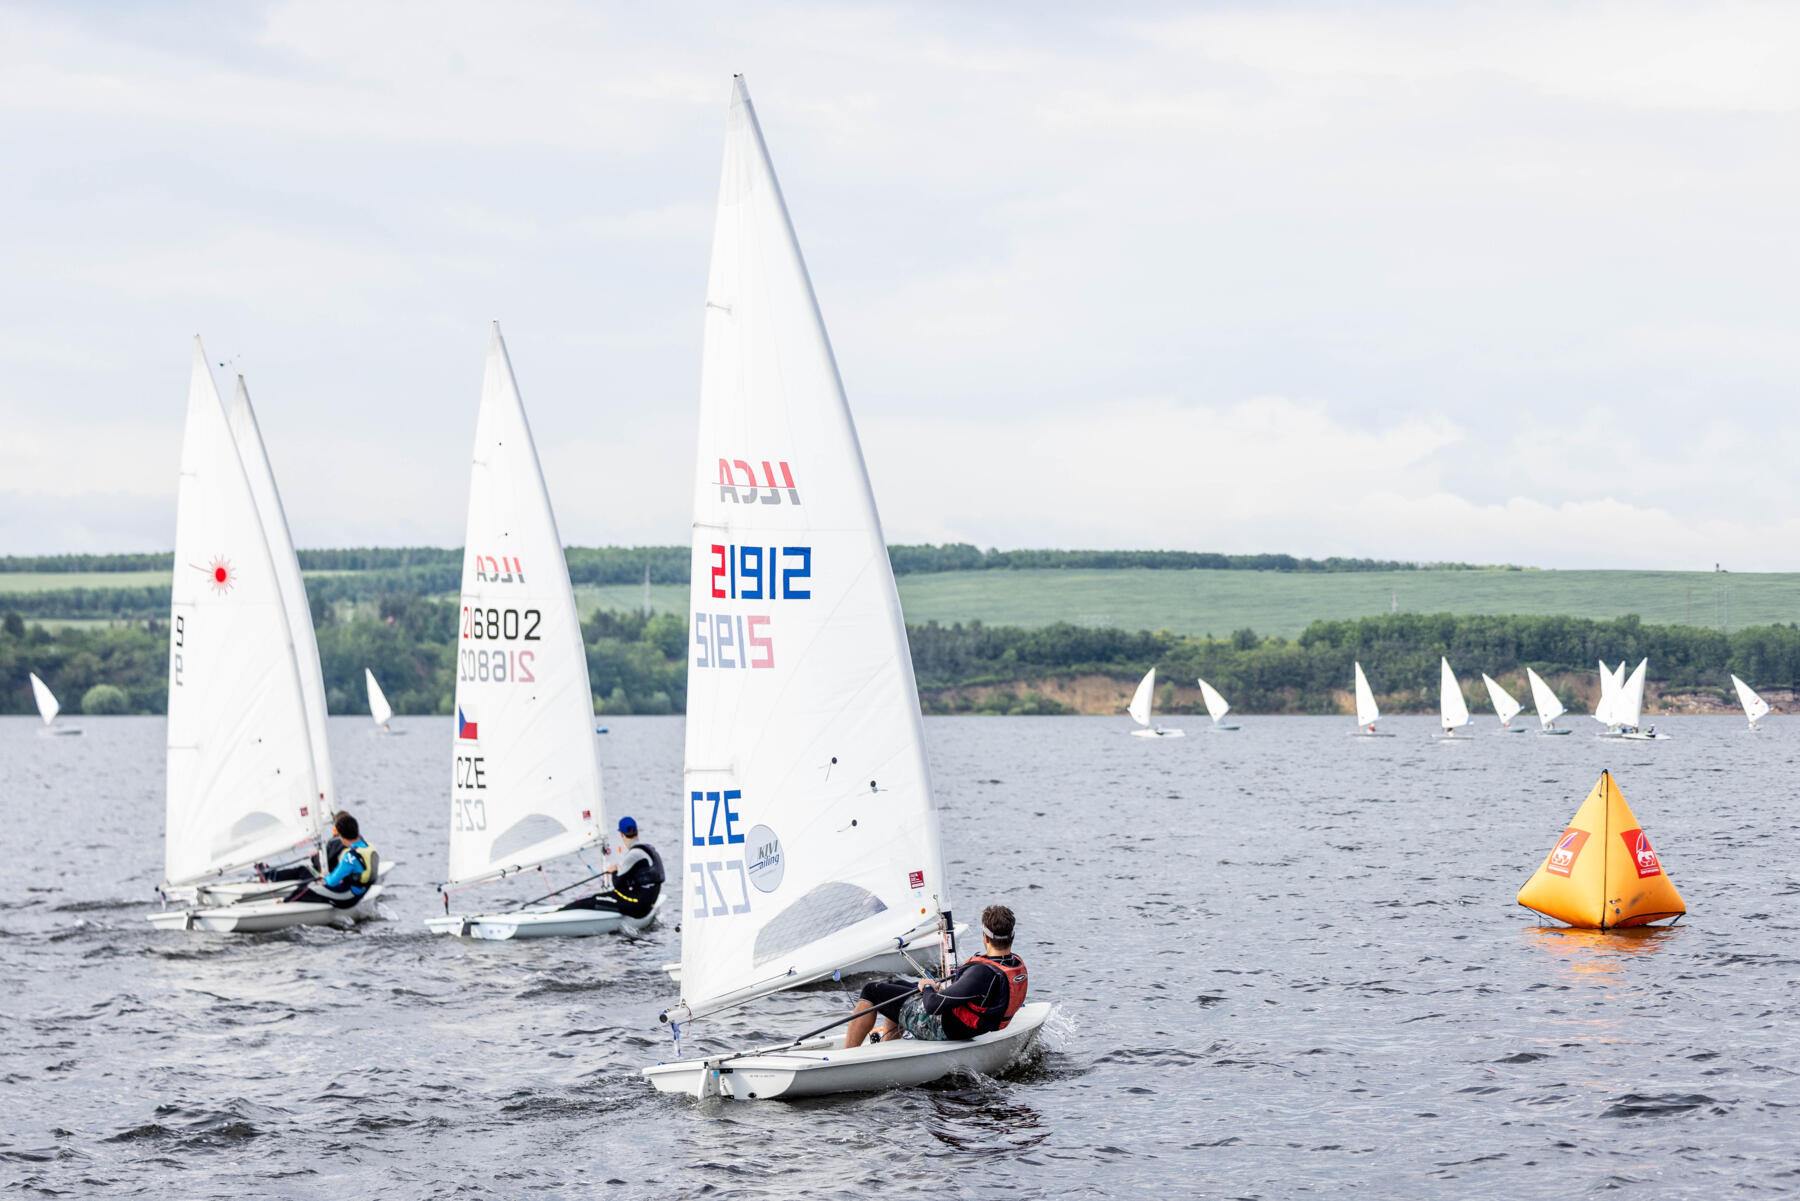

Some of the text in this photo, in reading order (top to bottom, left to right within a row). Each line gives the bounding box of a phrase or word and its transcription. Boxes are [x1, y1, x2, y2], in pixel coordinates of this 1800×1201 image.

[711, 544, 811, 600] 21912
[463, 606, 541, 641] 216802
[456, 756, 487, 789] CZE
[691, 789, 745, 846] CZE
